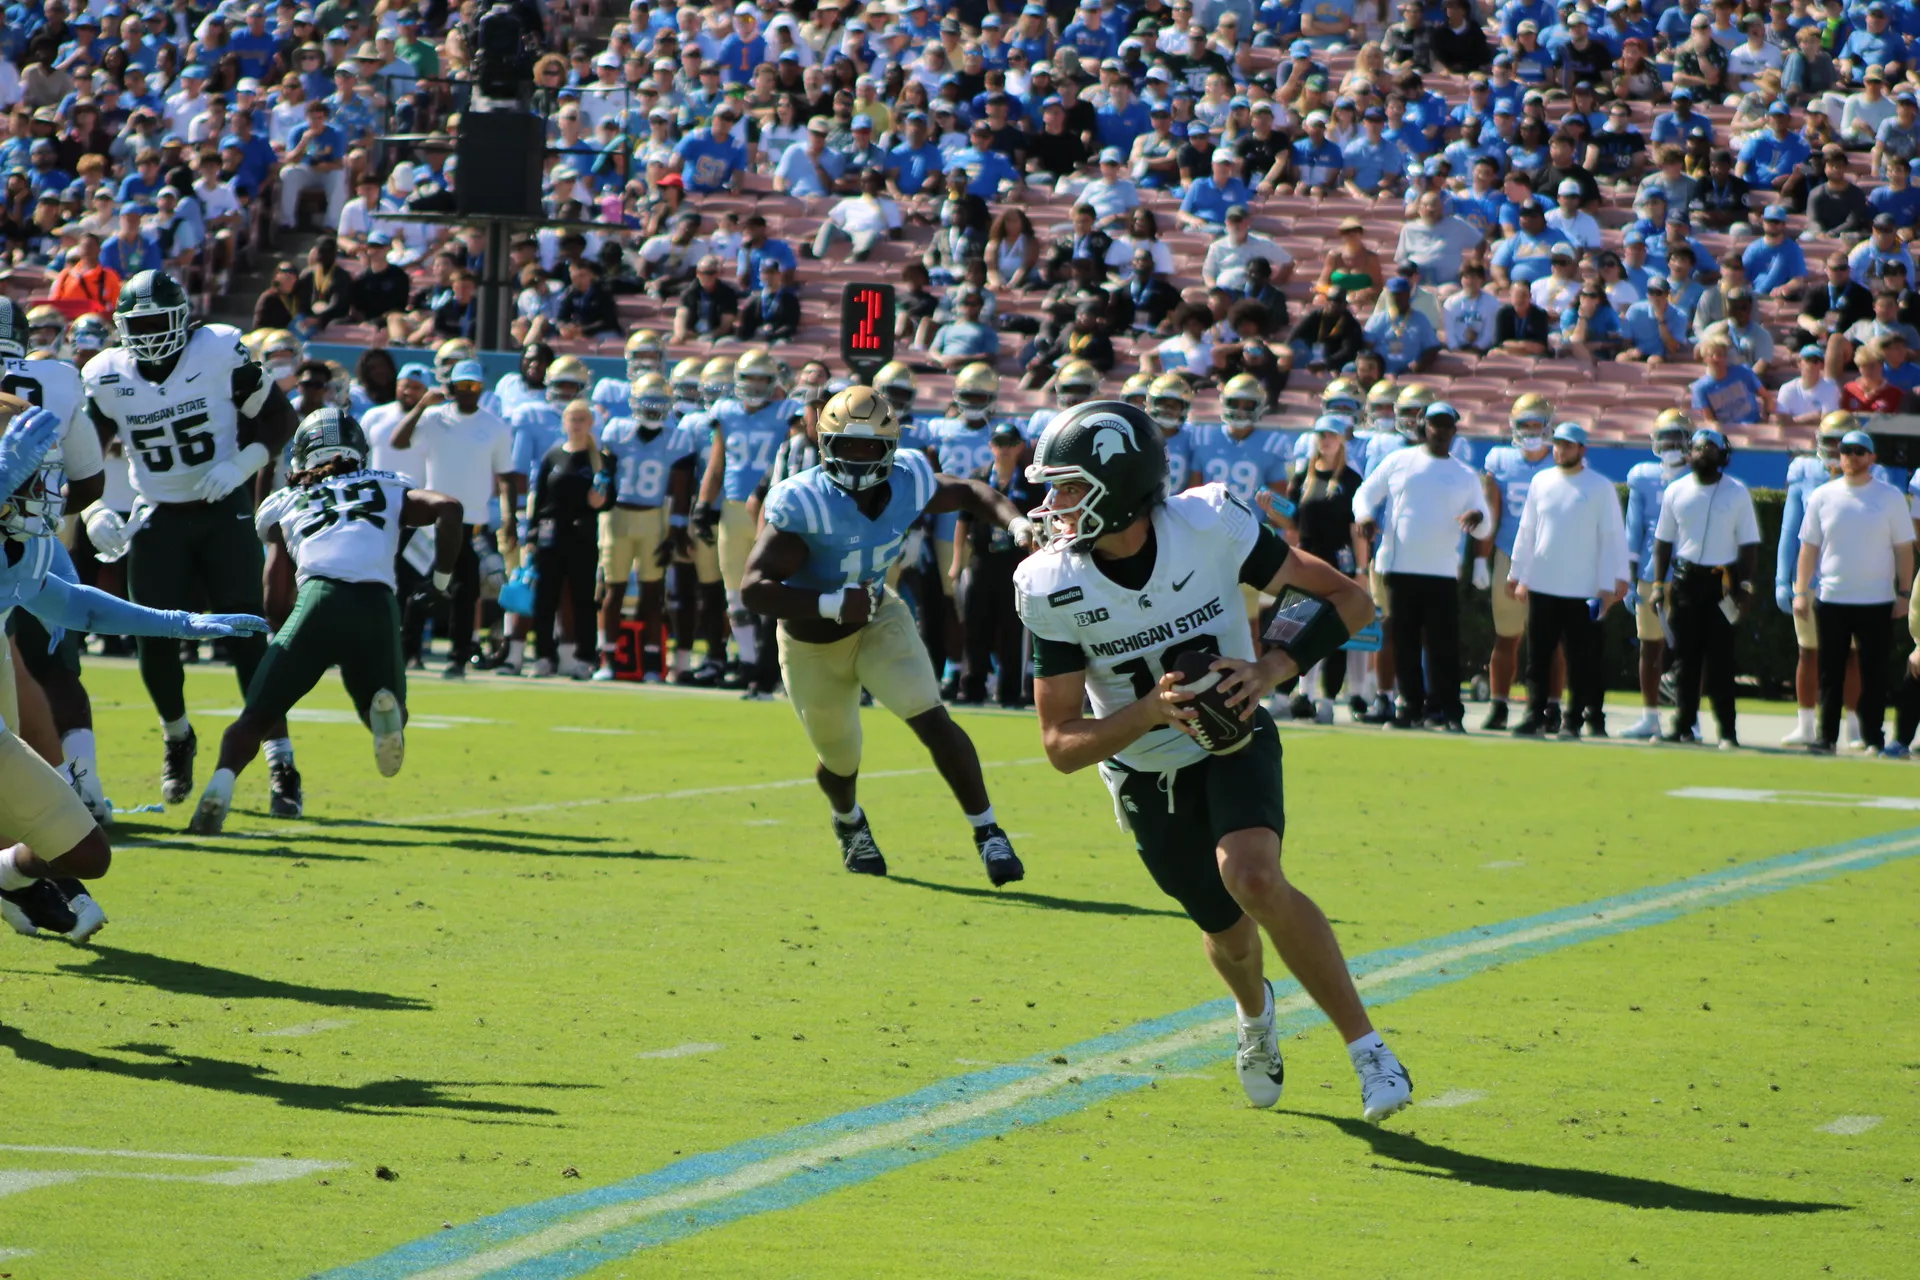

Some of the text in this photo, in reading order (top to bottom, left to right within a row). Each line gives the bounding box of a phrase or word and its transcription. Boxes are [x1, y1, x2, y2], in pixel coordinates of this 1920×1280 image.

[852, 289, 882, 349] 2
[125, 397, 208, 426] MICHIGAN STATE
[130, 412, 216, 473] 55
[616, 456, 664, 499] 18
[1054, 589, 1082, 603] msufcu
[1089, 596, 1224, 657] MICHIGAN STATE
